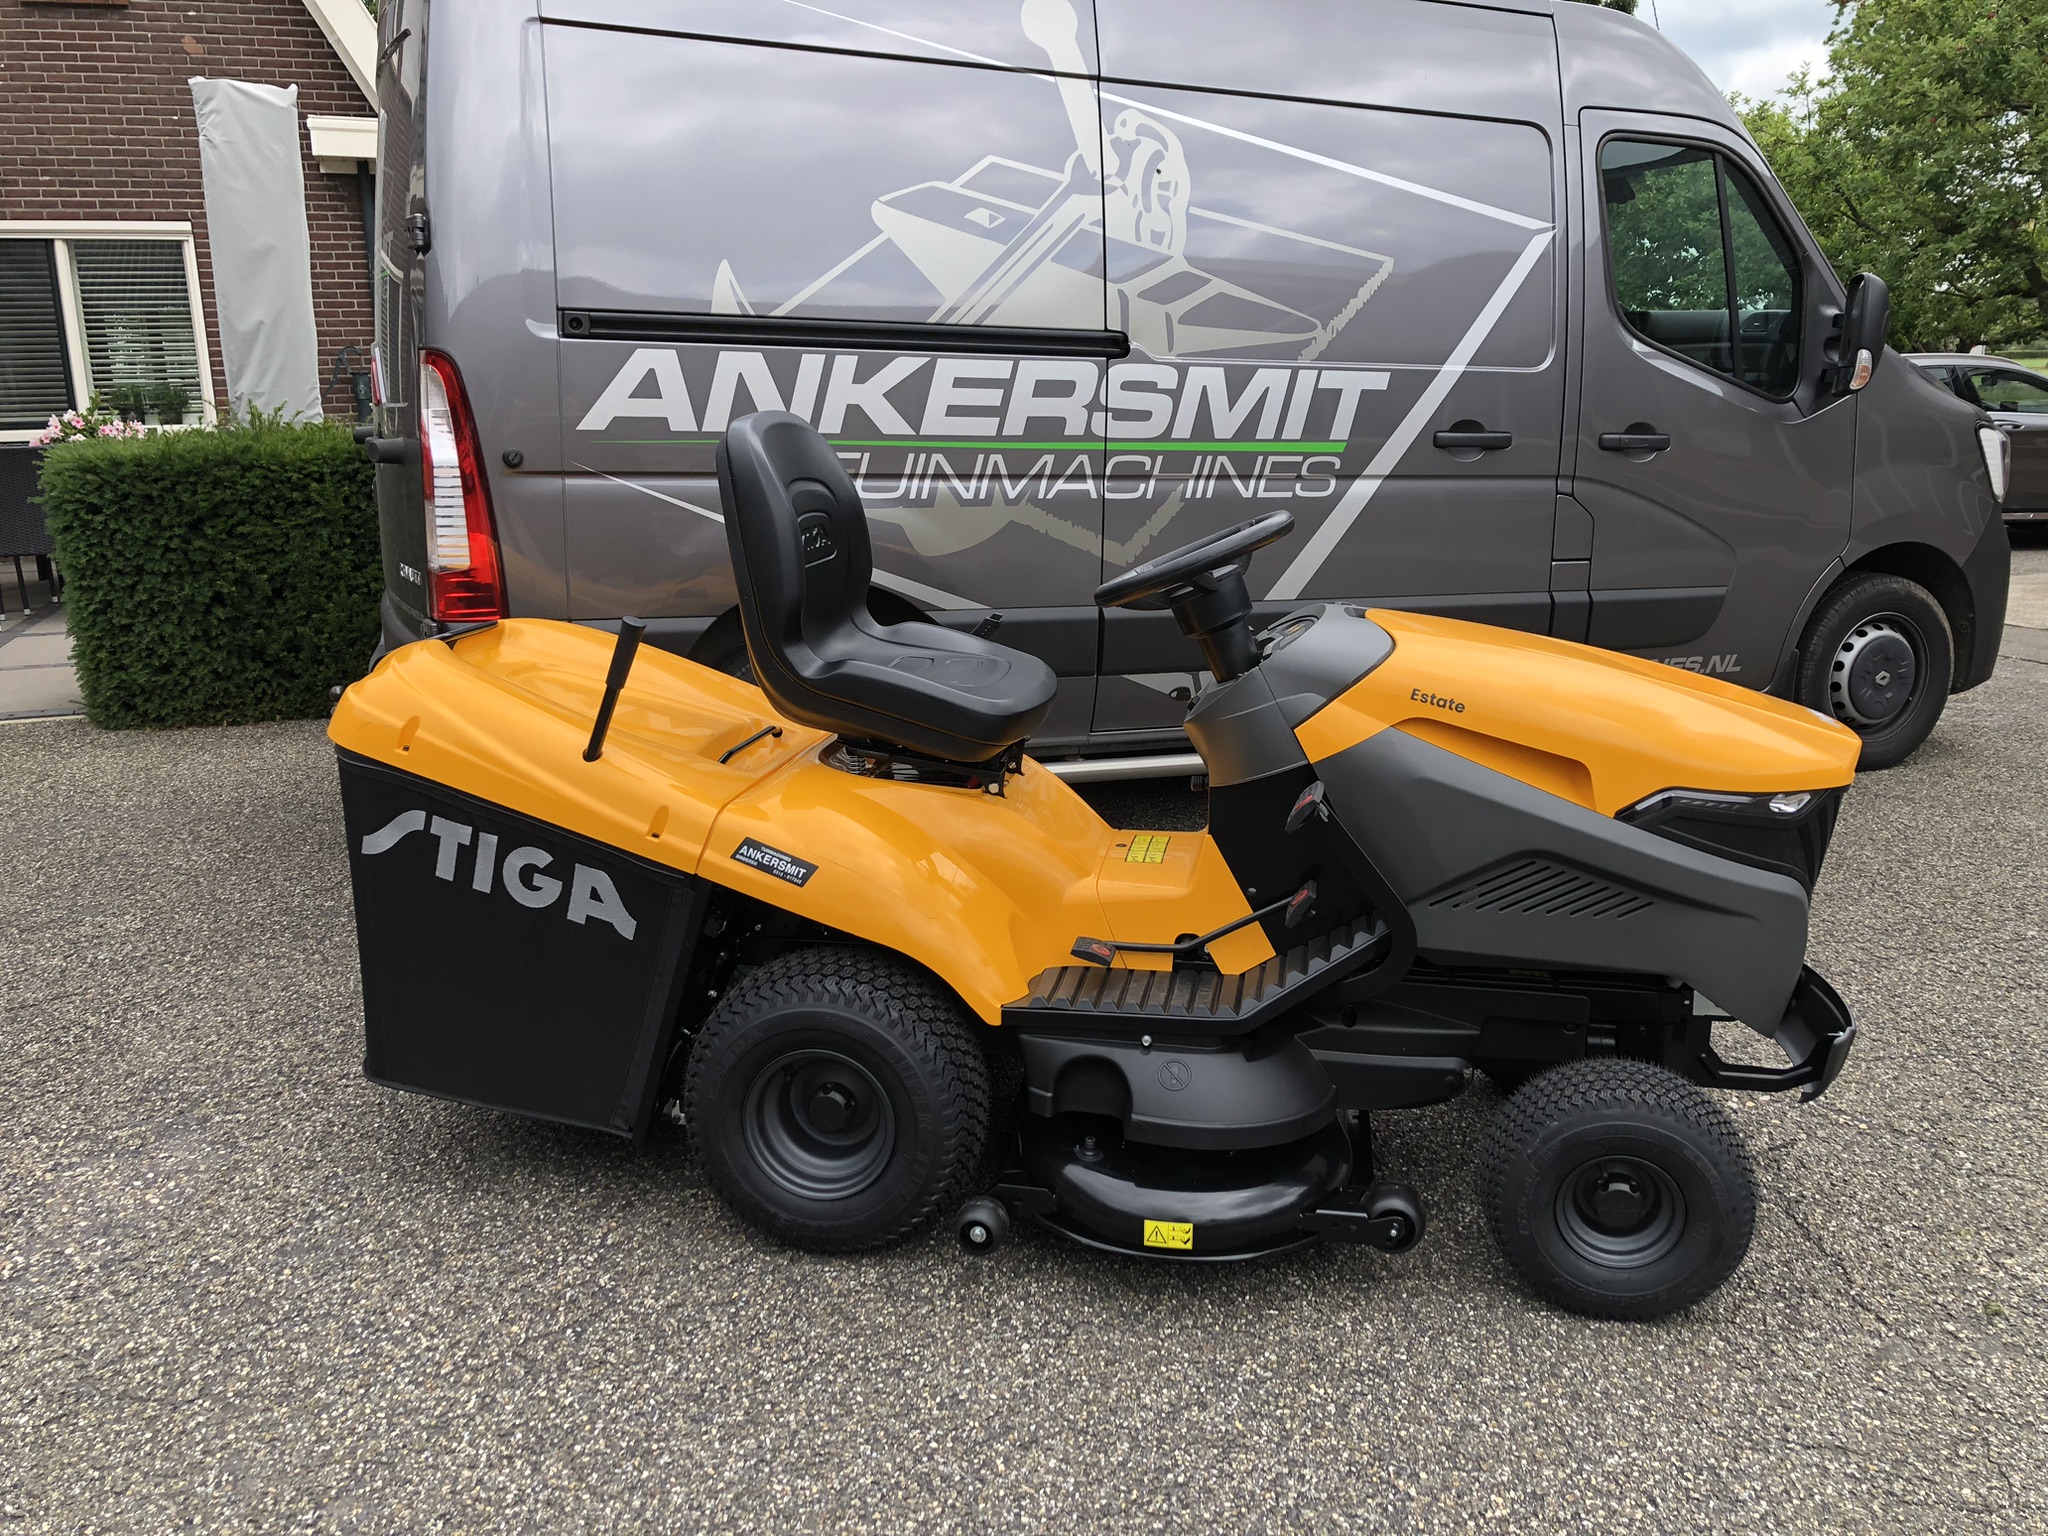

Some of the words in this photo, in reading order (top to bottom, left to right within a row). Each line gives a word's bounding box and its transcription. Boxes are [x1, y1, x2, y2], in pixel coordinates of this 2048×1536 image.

[575, 347, 1392, 441] ANKERSMIT
[1410, 688, 1466, 713] Estate
[361, 809, 637, 940] STIGA
[738, 845, 807, 878] ANKERSMIT
